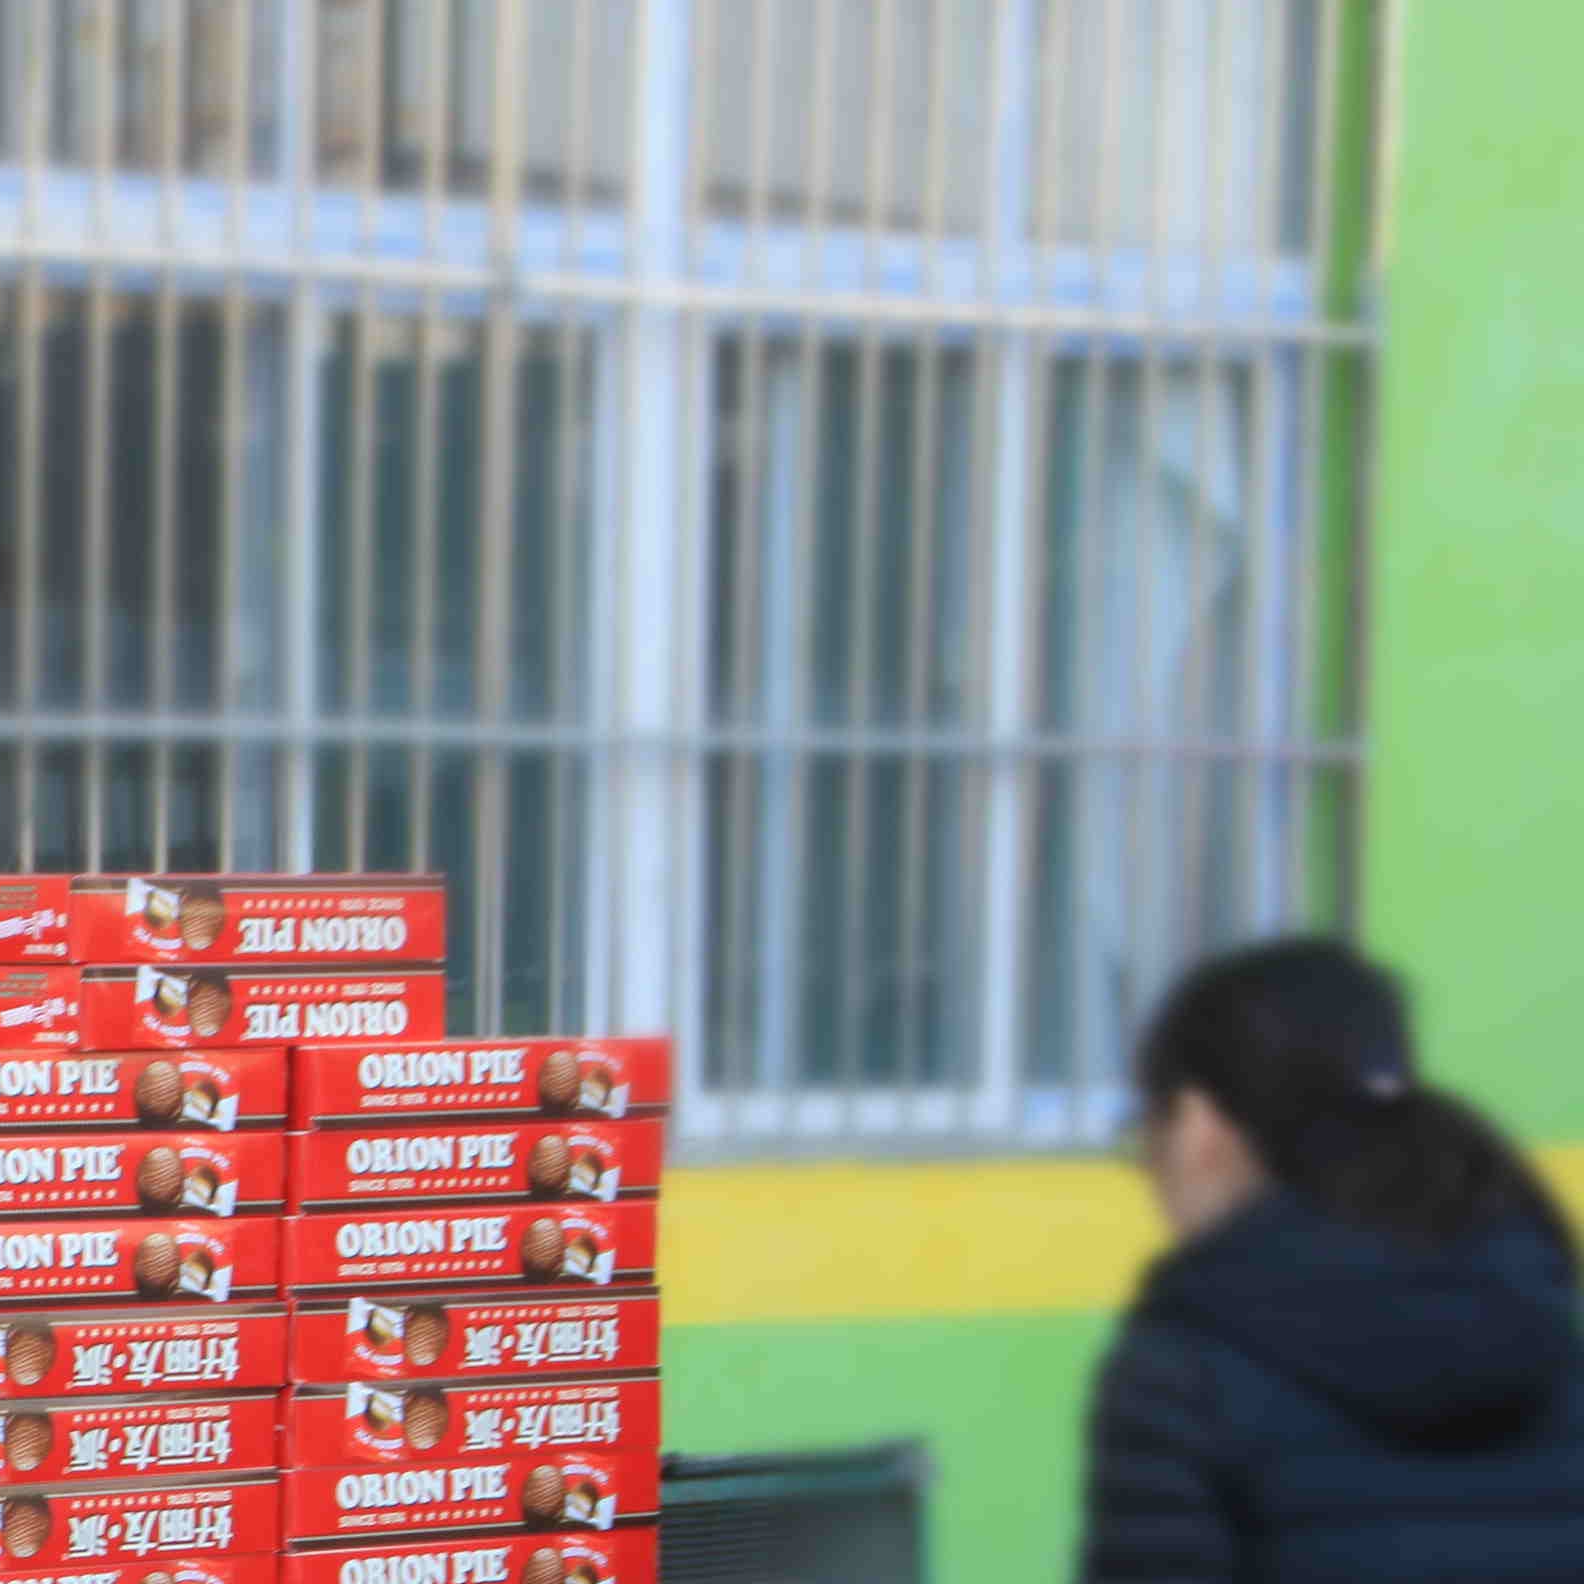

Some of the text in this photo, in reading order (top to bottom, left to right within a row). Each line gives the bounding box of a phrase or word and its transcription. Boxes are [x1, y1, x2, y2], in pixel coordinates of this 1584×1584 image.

[235, 916, 407, 954] ORION PIE
[243, 1000, 408, 1040] ORION PIE
[55, 1059, 119, 1095] PIE
[358, 1049, 526, 1089] ORION PIE
[59, 1144, 123, 1182] PIE
[346, 1132, 516, 1174] ORION PIE
[57, 1229, 121, 1268] PIE
[335, 1216, 509, 1258] ORION PIE
[335, 1464, 509, 1509] ORION PIE
[450, 1547, 510, 1584] PIE
